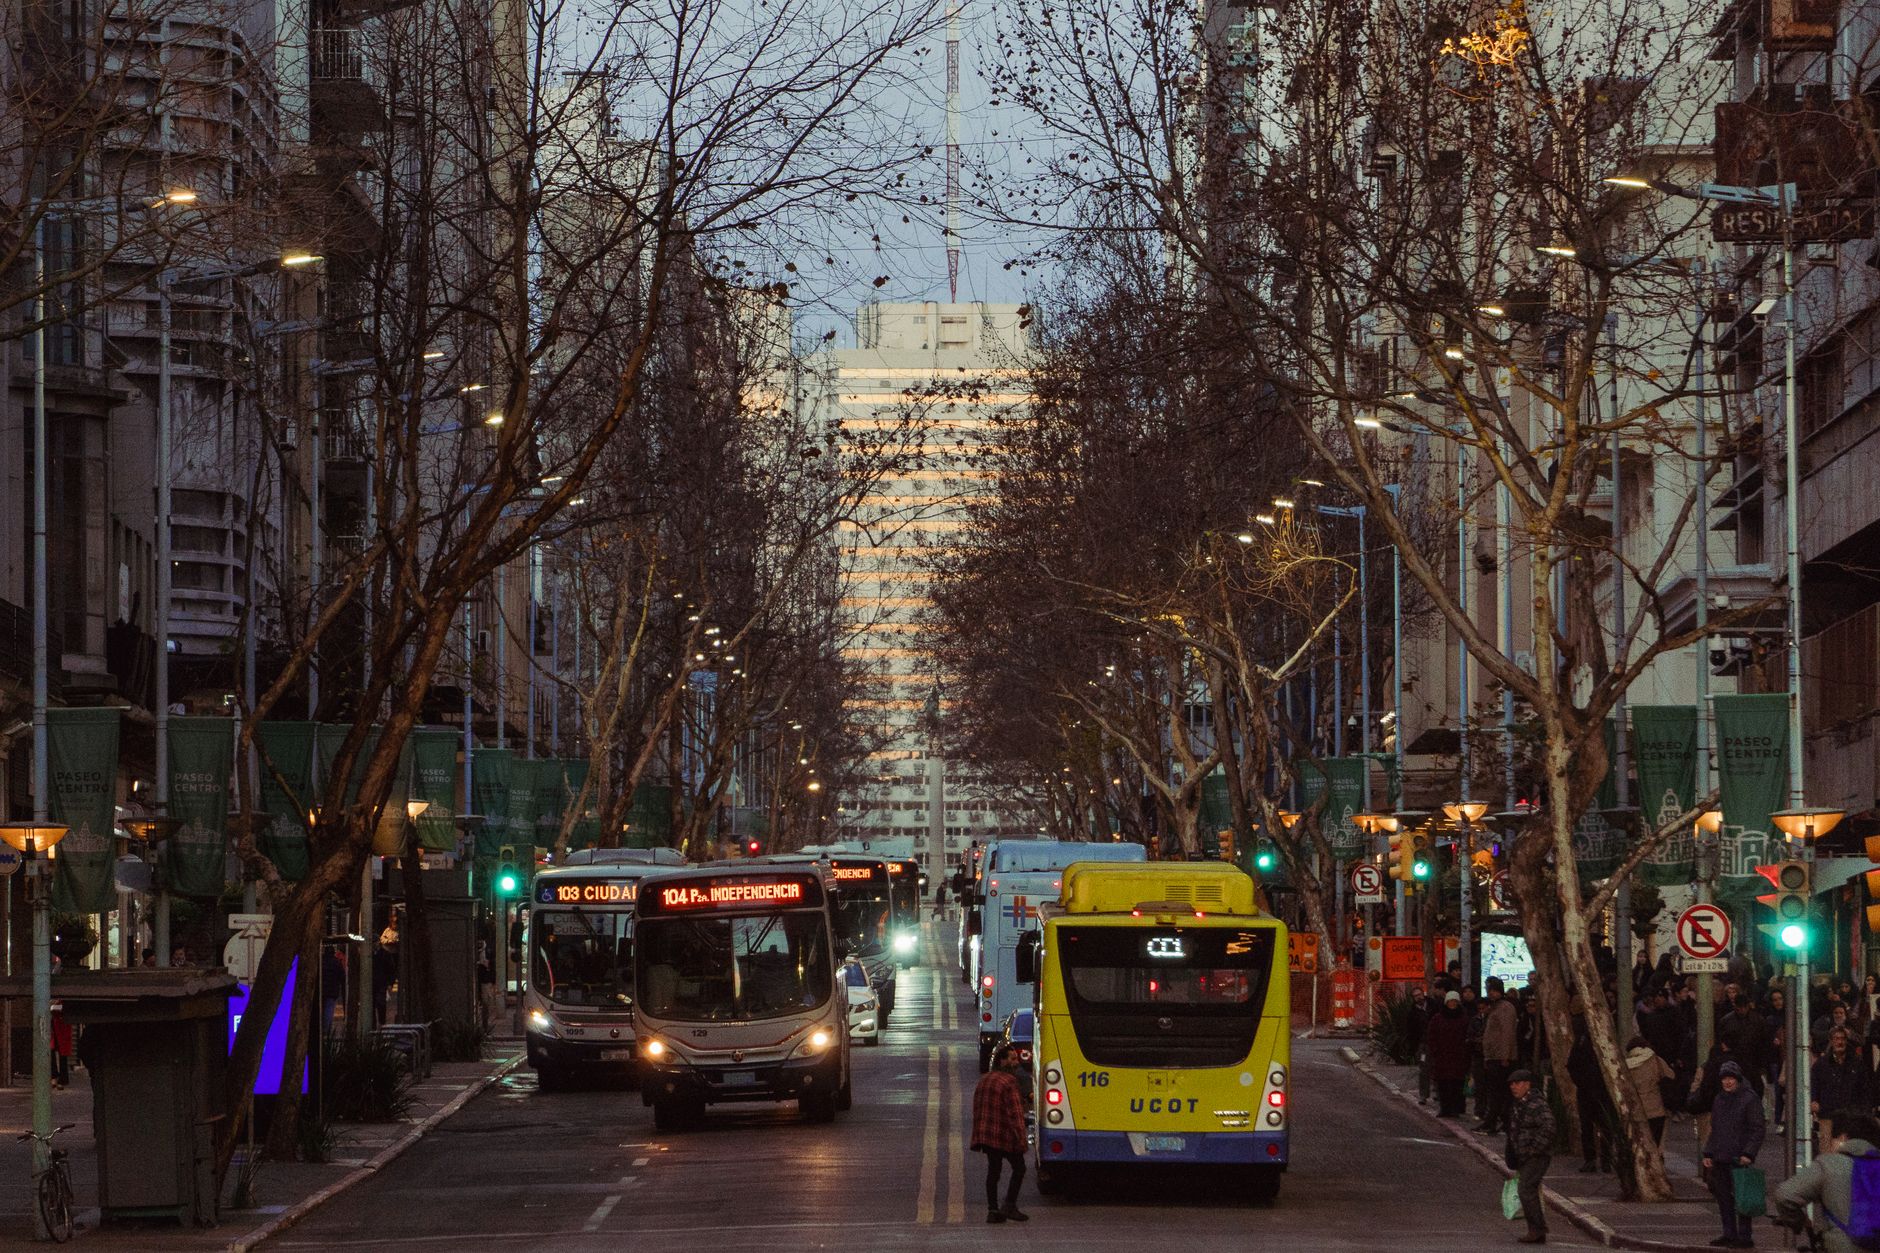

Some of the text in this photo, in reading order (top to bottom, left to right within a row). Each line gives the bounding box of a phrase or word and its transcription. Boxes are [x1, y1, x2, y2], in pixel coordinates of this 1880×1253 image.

[1642, 741, 1683, 750] PASEO
[1724, 736, 1772, 747] PASEO
[1641, 751, 1692, 761] CENTRO
[1724, 748, 1782, 759] CENTRO
[57, 771, 101, 782] PASEO
[174, 772, 214, 783] PASEO
[56, 783, 109, 794] CENTRO
[174, 783, 221, 794] CENTRO
[557, 887, 580, 901] 103
[663, 888, 688, 905] 104
[711, 883, 800, 902] INDEPENDENCIA
[691, 1029, 708, 1038] 129
[1077, 1071, 1110, 1087] 116
[1129, 1098, 1199, 1114] UCOT
